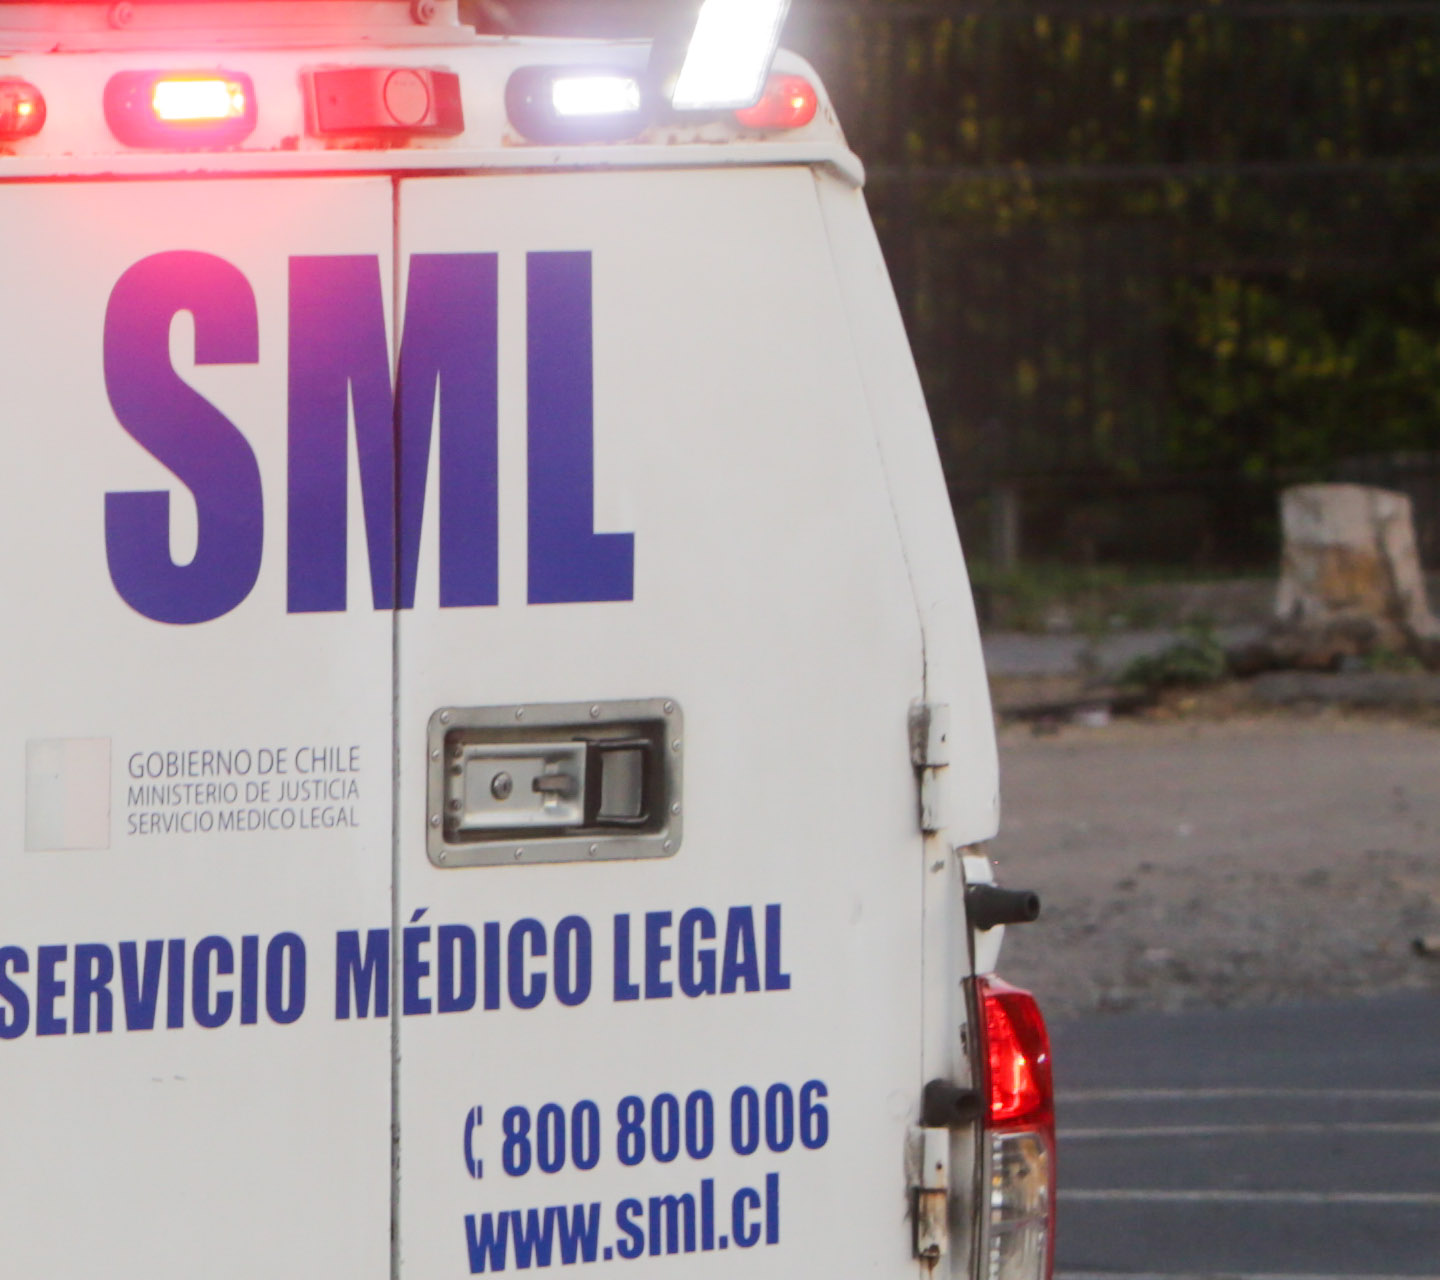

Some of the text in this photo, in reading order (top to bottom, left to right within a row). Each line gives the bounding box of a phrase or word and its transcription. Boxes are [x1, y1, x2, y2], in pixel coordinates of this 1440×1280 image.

[104, 250, 634, 624] SML
[127, 778, 360, 807] MINISTERIO DE JUSTICIA
[128, 745, 361, 779] GOBIERNO DE CHILE
[128, 805, 360, 835] SERVICIO MEDICO LEGAL
[335, 907, 592, 1020] MÉDICO
[612, 903, 791, 1002] LEGAL
[501, 1079, 829, 1177] 800 800 006
[464, 1171, 779, 1275] www.sml.cl
